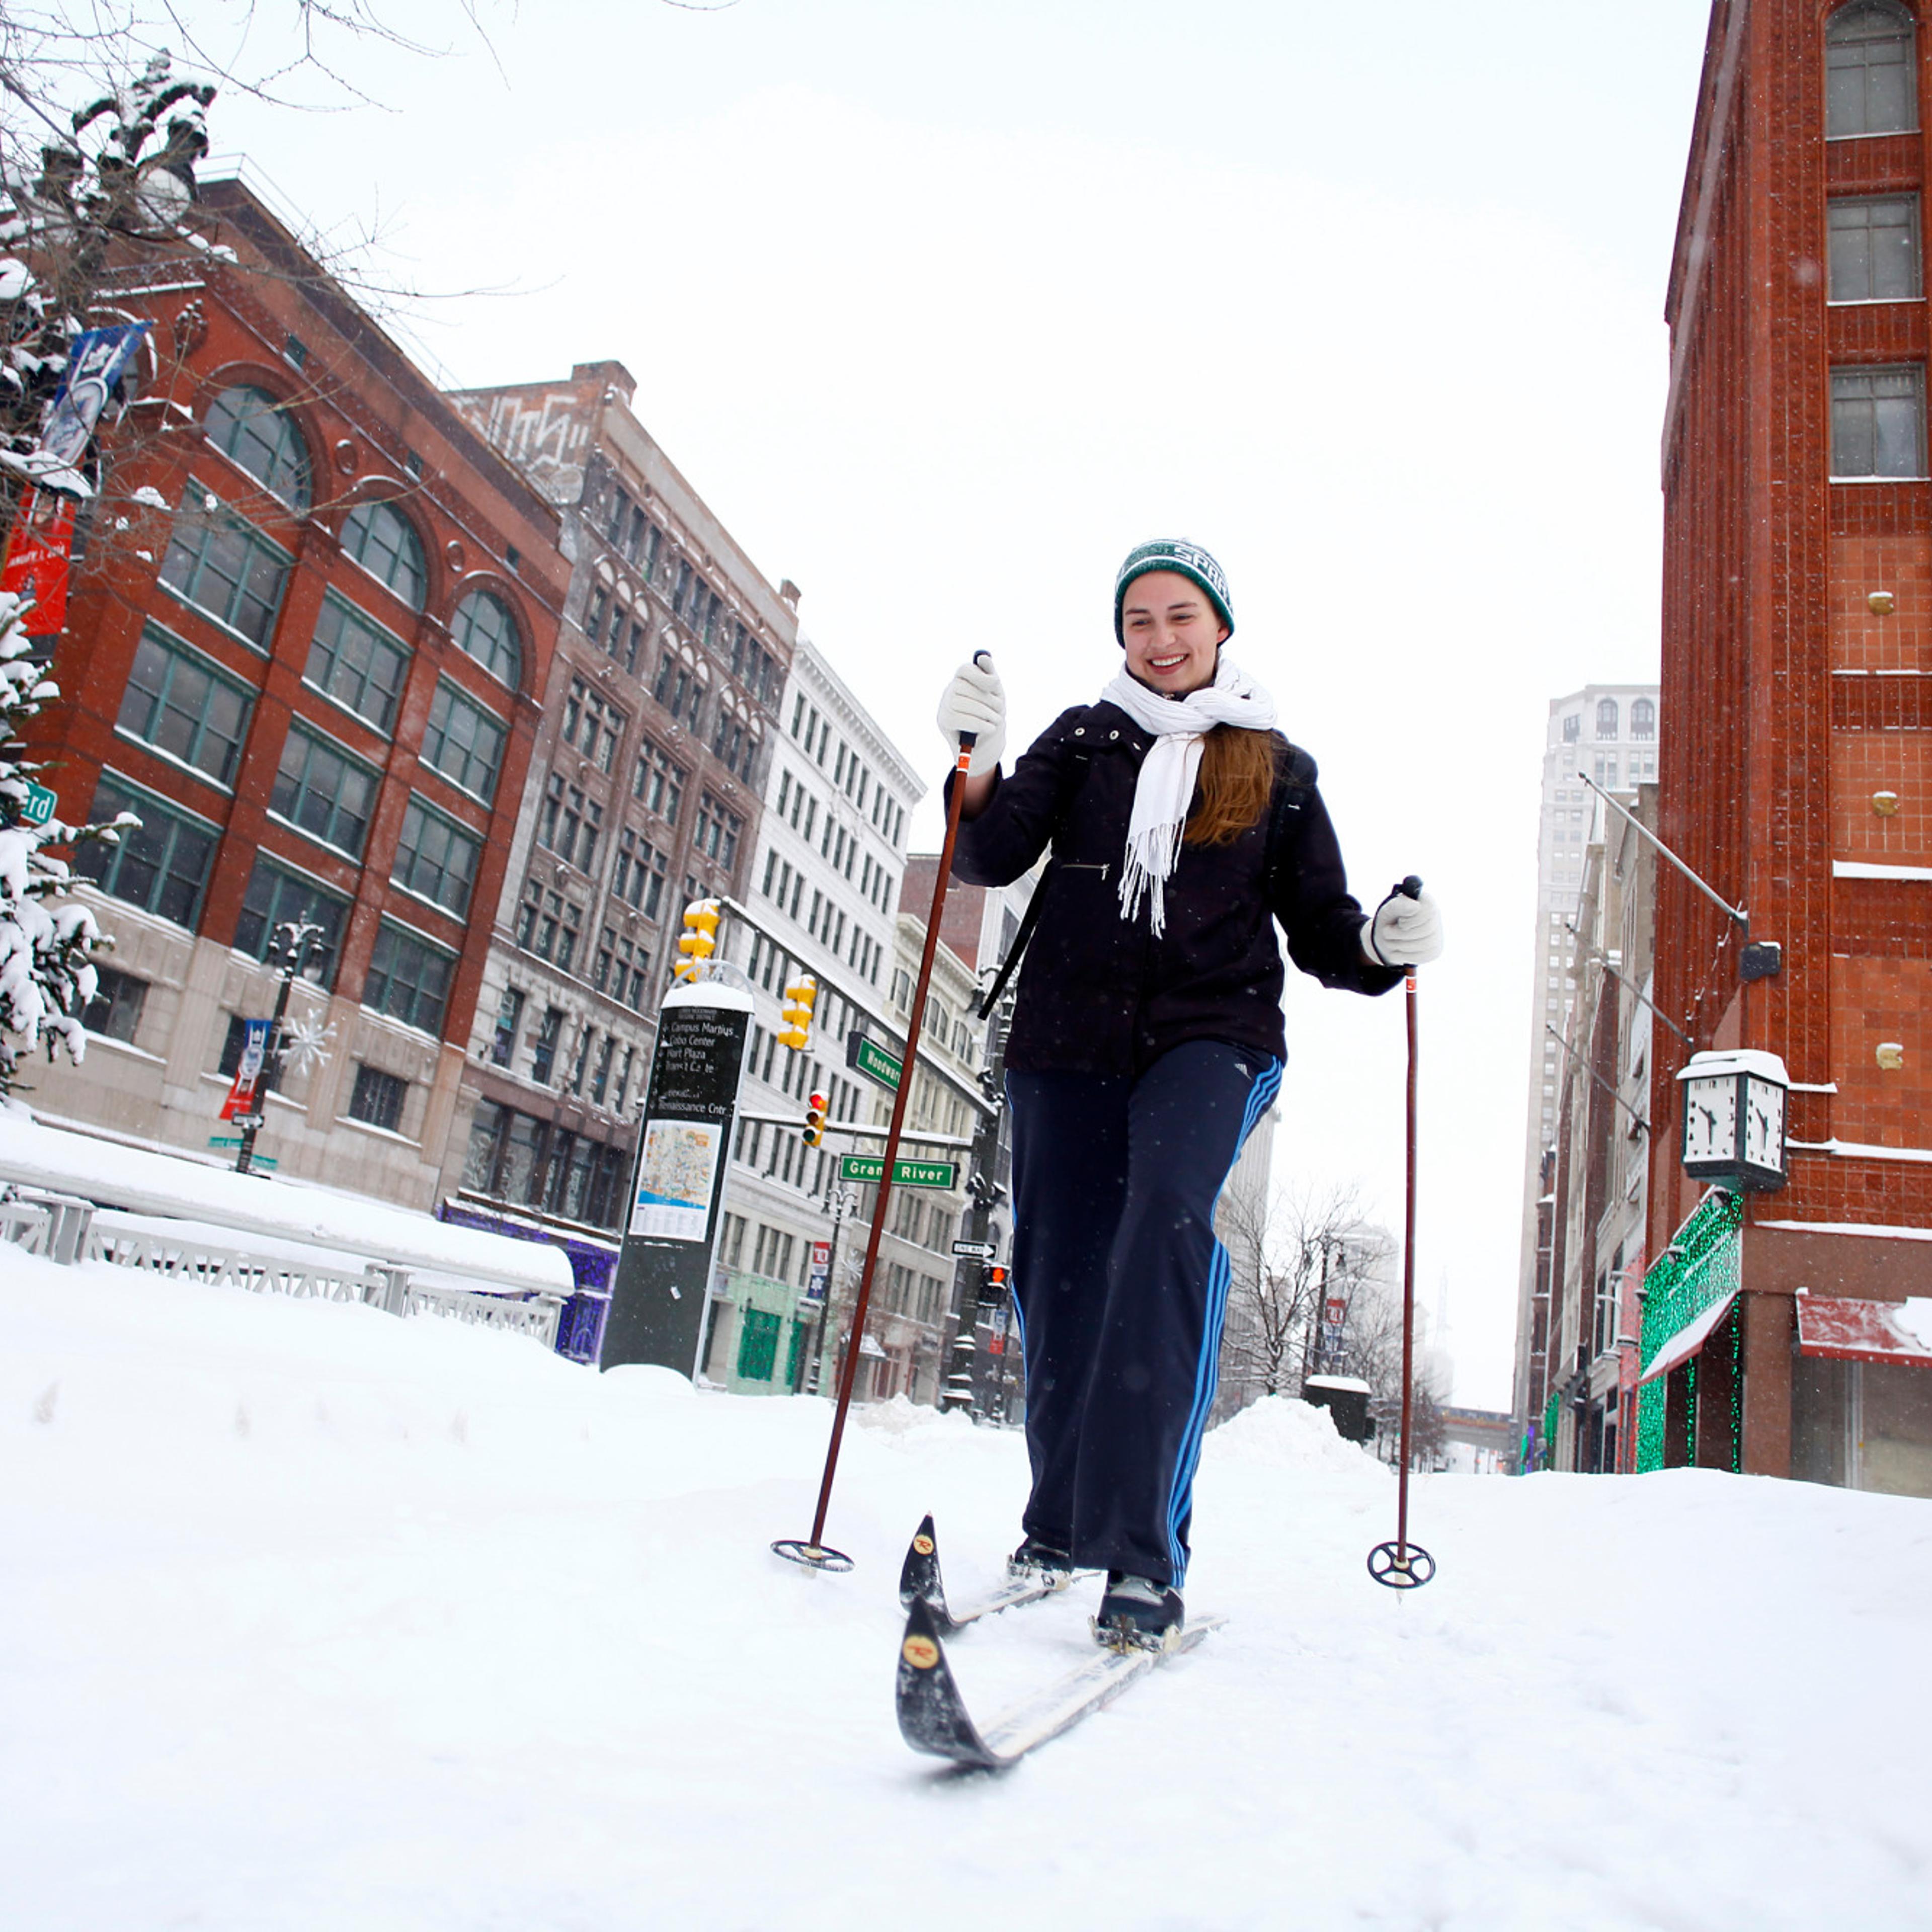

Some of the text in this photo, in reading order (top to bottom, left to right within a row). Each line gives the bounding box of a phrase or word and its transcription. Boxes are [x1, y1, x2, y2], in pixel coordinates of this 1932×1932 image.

[671, 1021, 734, 1037] Campus Martius
[670, 1033, 716, 1047] Cobo Center
[684, 1048, 706, 1059] Plaza
[867, 1050, 902, 1084] Woodwar
[1709, 1079, 1717, 1088] 12
[658, 1099, 727, 1115] Renaissance Cntr
[849, 1161, 943, 1181] Gran River
